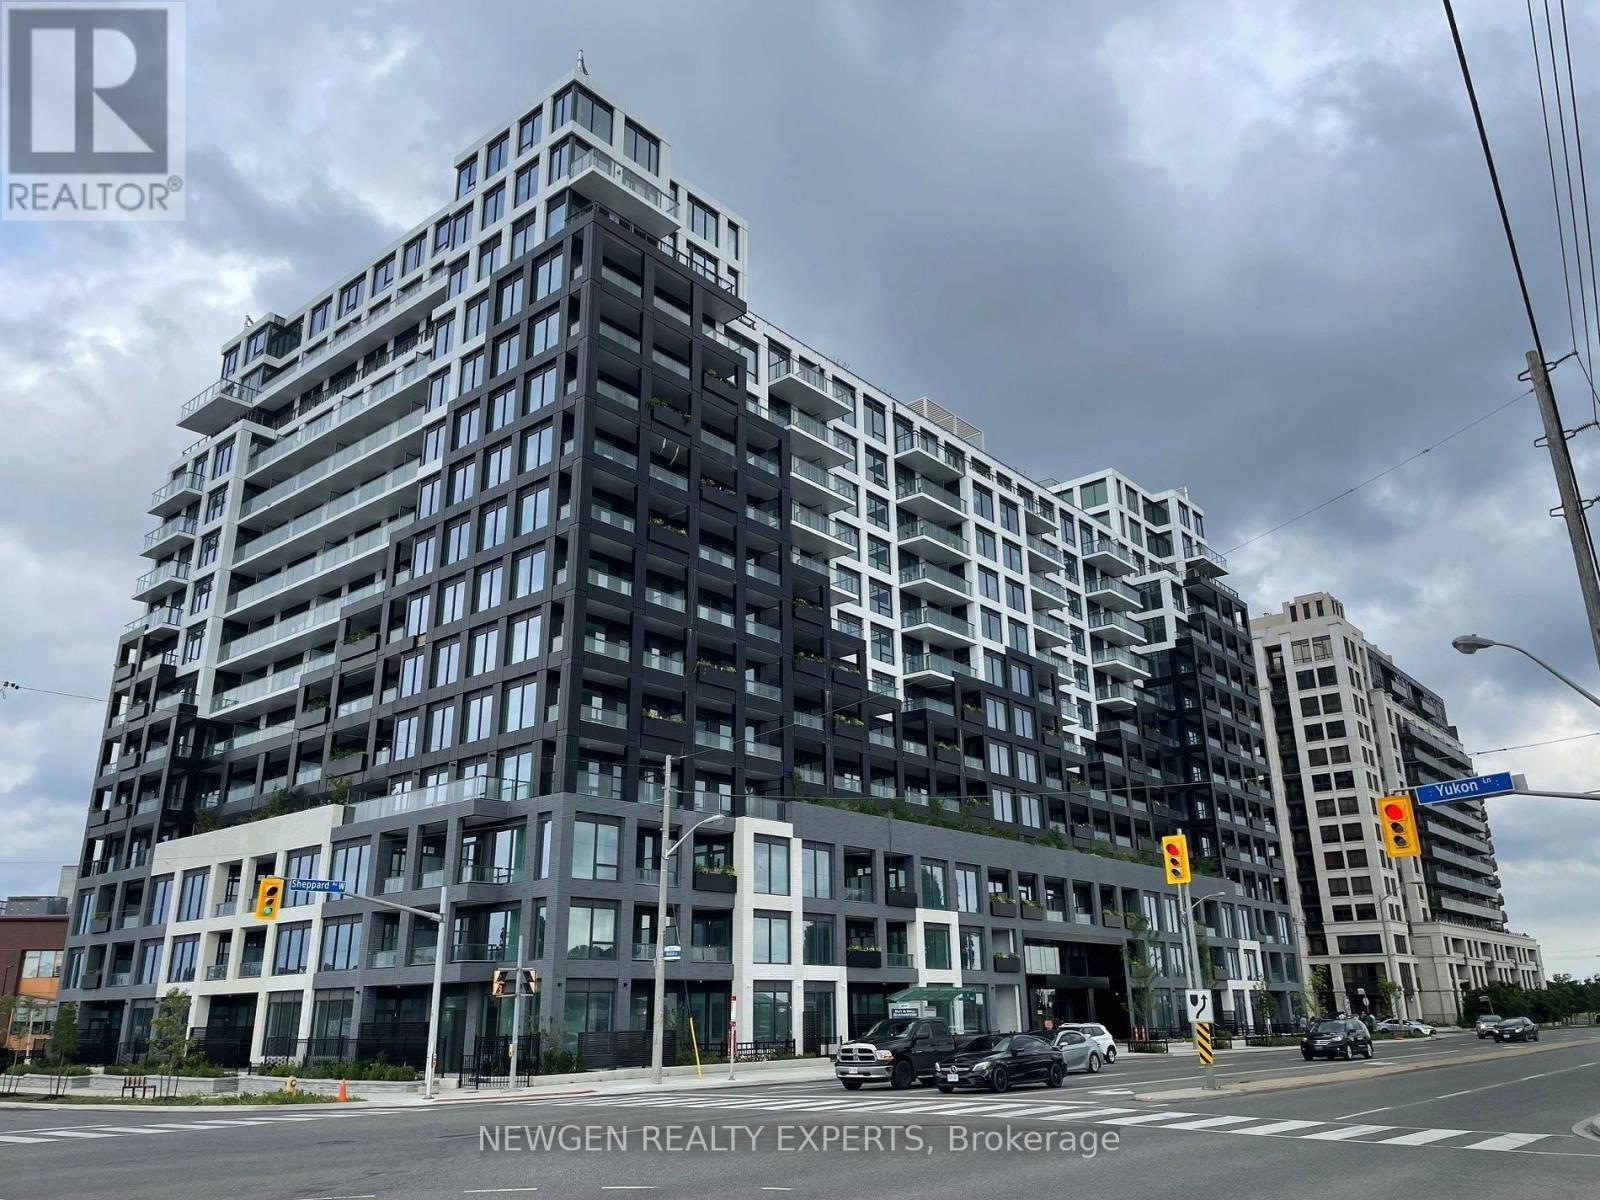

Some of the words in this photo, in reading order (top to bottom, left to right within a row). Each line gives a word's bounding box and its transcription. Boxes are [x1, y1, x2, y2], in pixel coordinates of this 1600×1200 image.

[1435, 781, 1479, 797] Yukon
[291, 880, 329, 890] Sheppard
[338, 882, 346, 890] W
